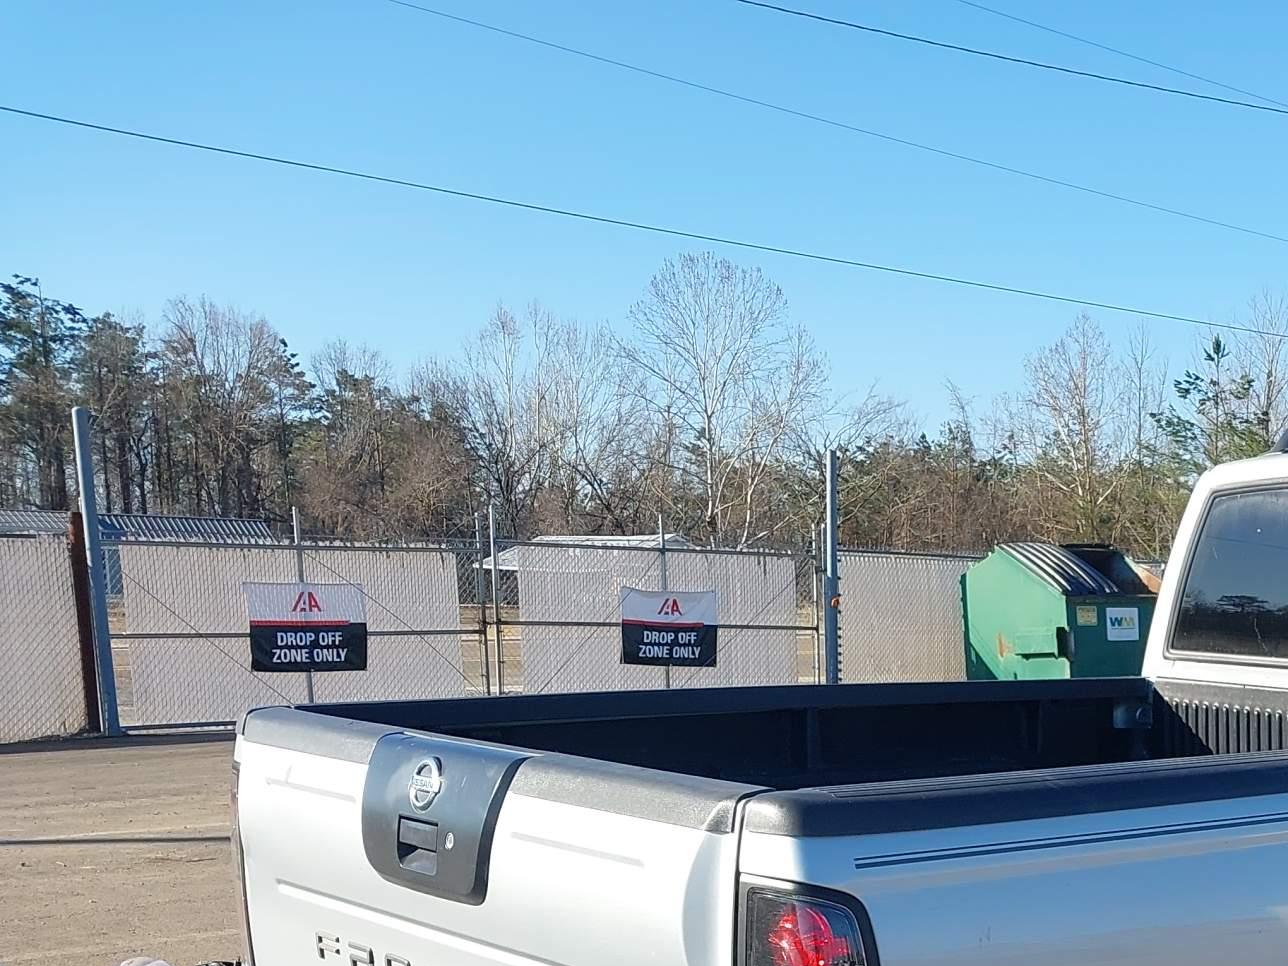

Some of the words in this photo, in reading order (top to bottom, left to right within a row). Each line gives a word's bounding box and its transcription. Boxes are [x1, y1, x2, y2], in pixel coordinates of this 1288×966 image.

[276, 632, 315, 647] DROP
[319, 631, 343, 646] OFF
[643, 630, 675, 644] DROP
[678, 632, 697, 645] OFF
[271, 648, 310, 663] ZONE
[313, 647, 348, 662] ONLY
[638, 645, 670, 659] ZONE
[672, 646, 701, 659] ONLY
